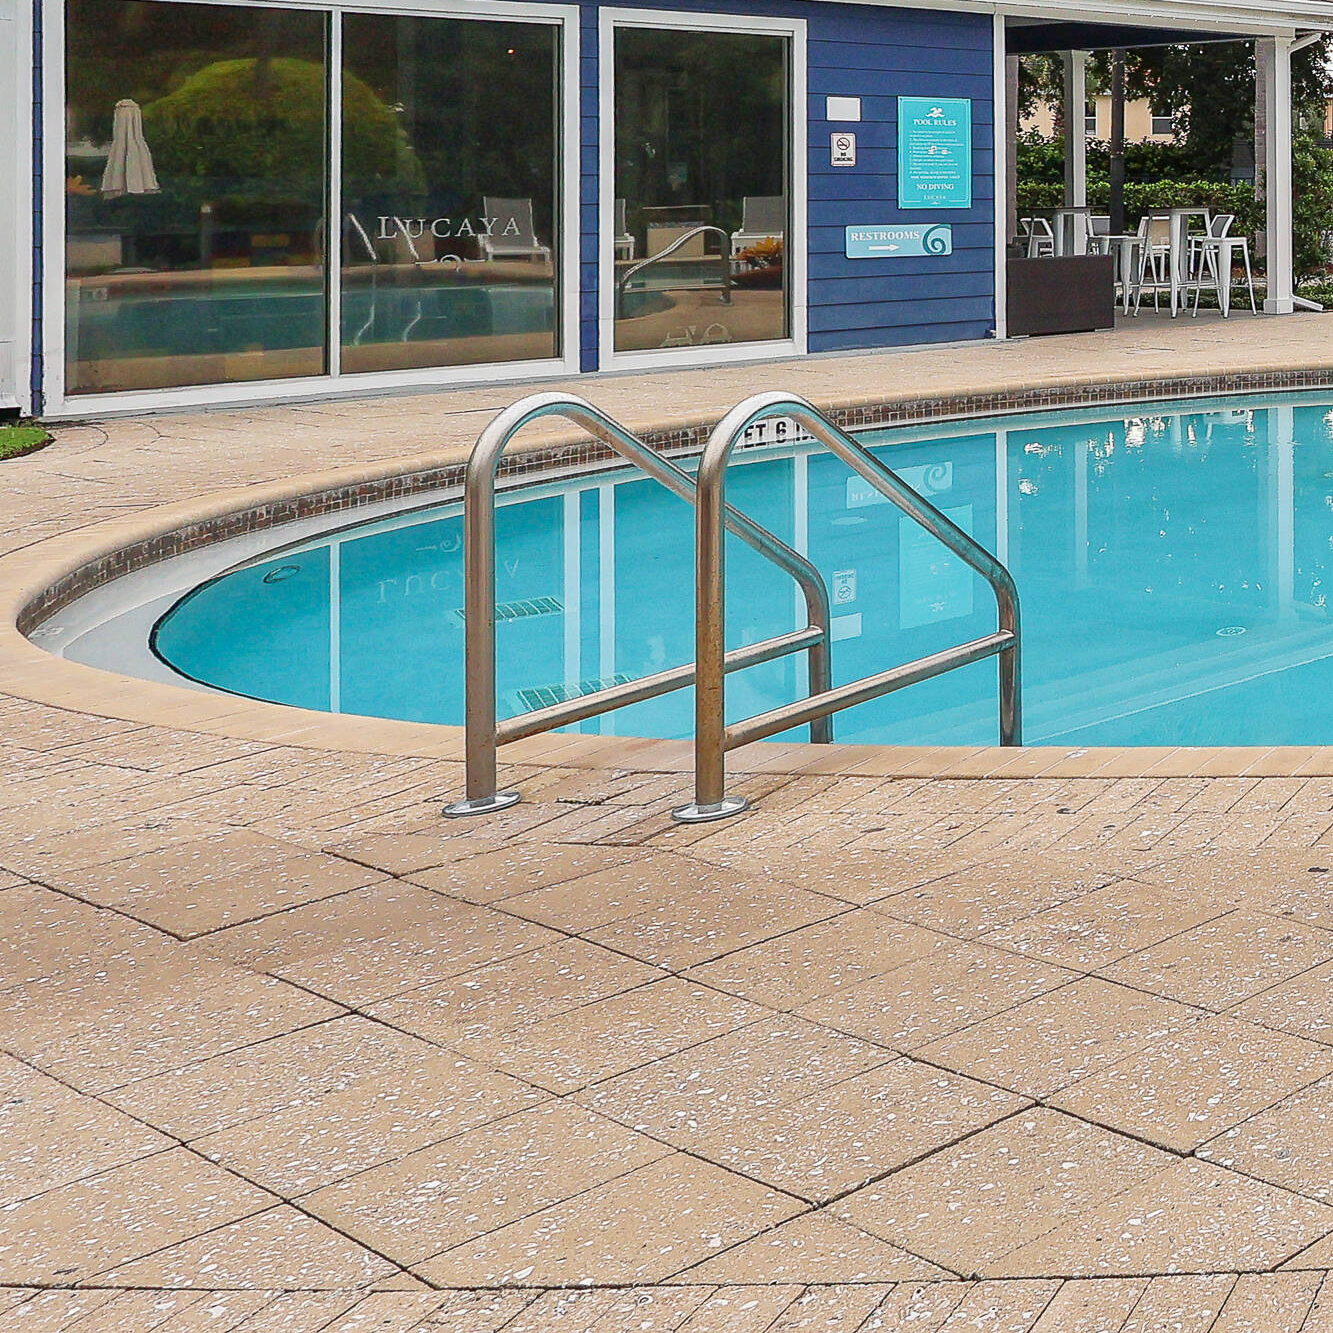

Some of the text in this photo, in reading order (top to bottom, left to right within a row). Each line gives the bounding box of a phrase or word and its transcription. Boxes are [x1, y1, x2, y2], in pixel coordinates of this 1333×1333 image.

[913, 118, 932, 126] POOL
[377, 216, 521, 239] LUCAYA
[851, 231, 920, 241] RESTROOMS
[775, 421, 787, 443] 6
